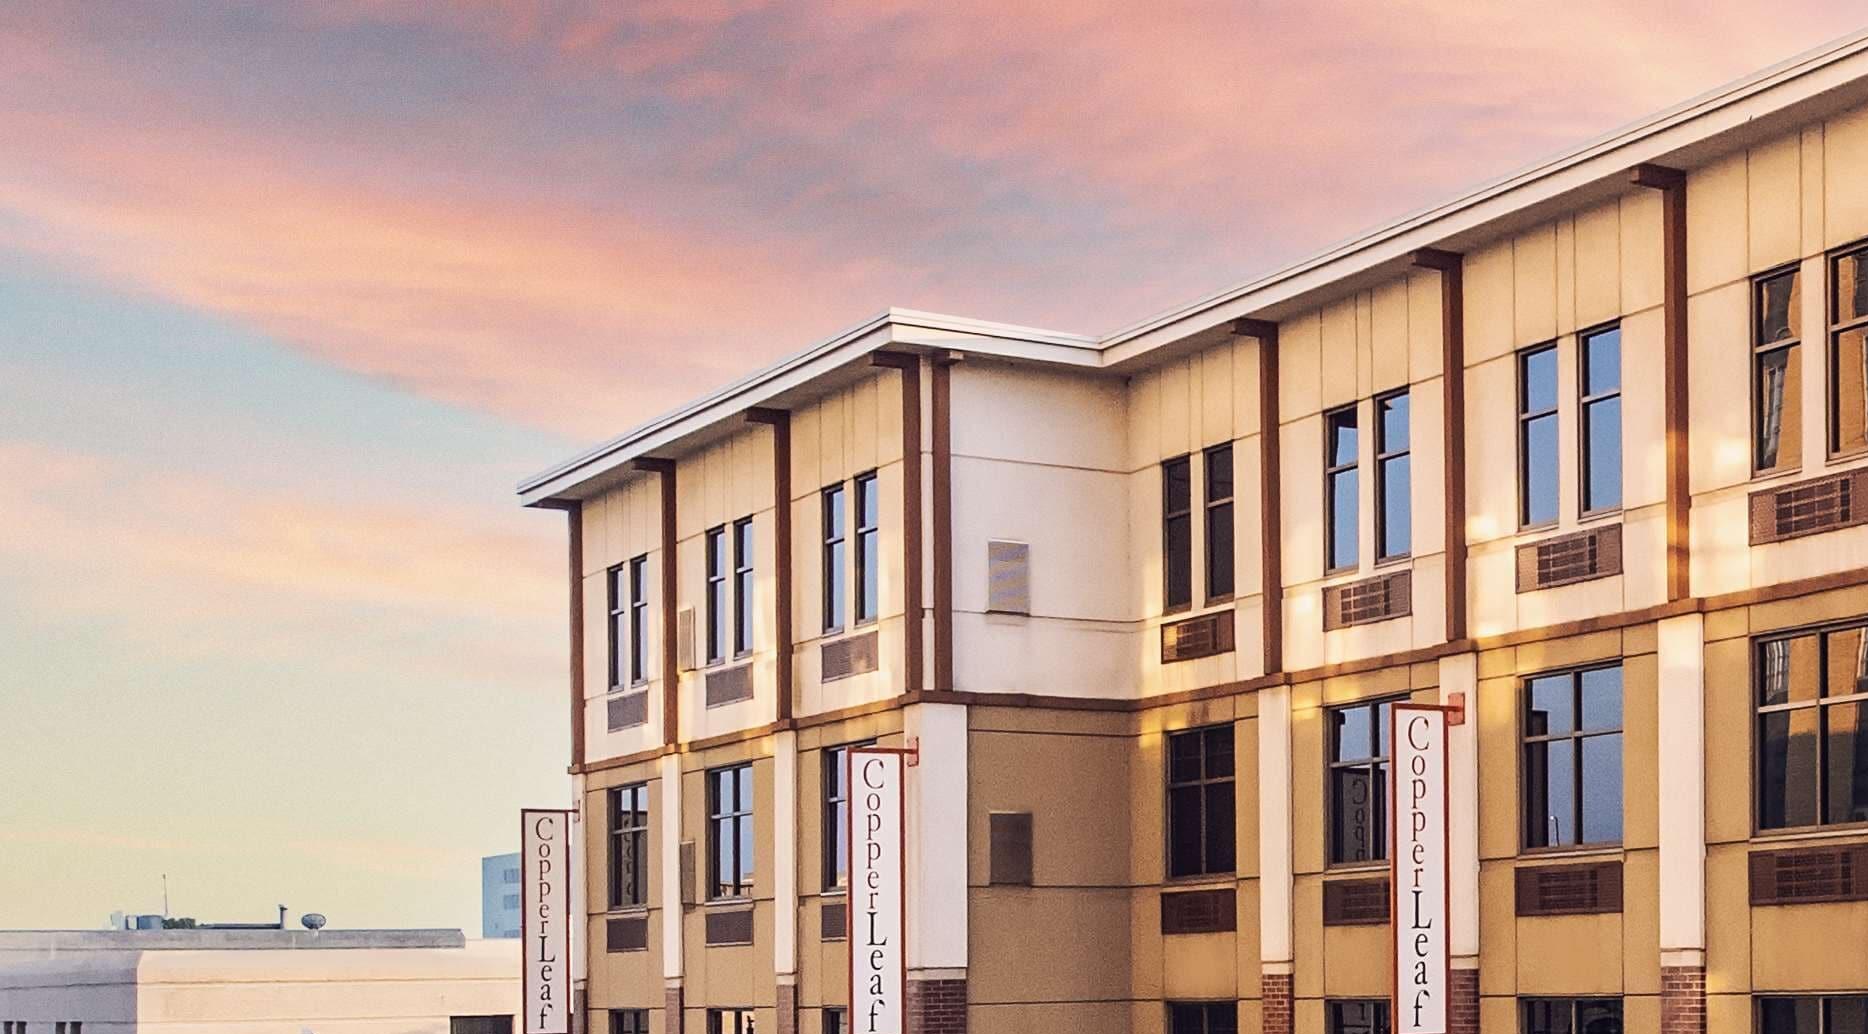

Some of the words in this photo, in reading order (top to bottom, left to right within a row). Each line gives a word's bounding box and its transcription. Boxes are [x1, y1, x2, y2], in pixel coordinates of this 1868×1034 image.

[535, 816, 555, 1029] CopperLeaf
[863, 758, 888, 1033] CopperLeaf
[1407, 715, 1433, 1028] CopperLeaf
